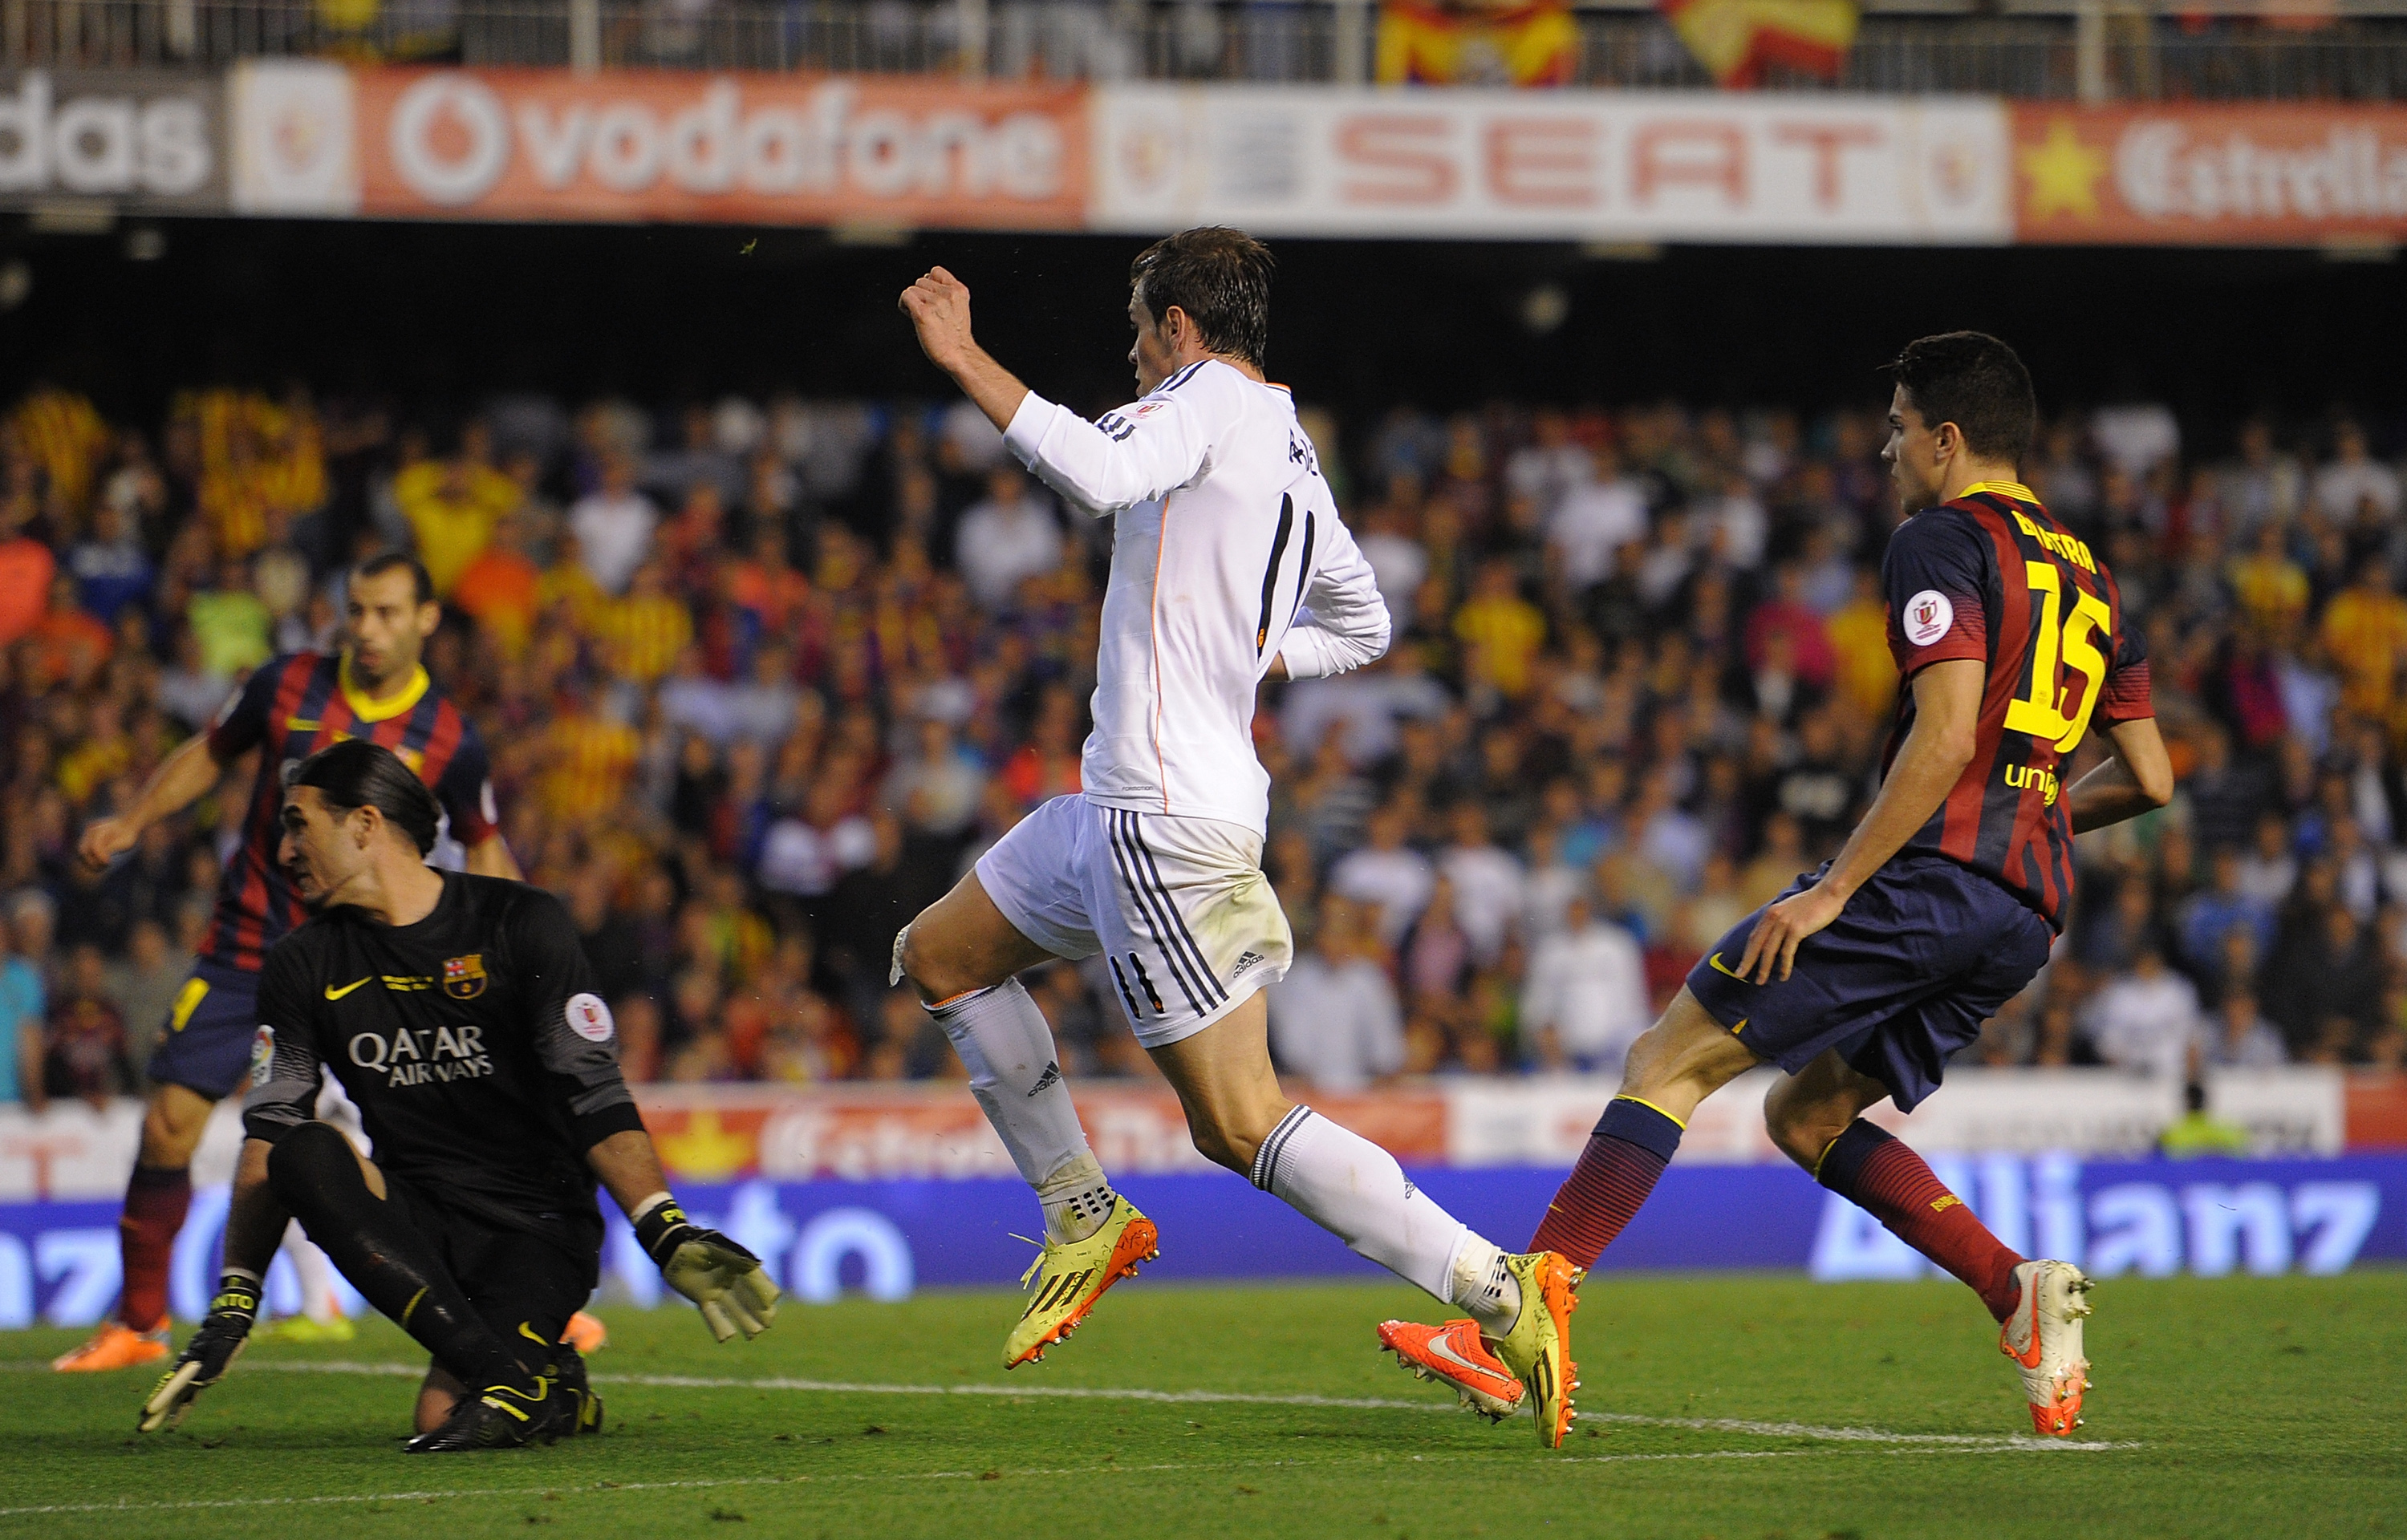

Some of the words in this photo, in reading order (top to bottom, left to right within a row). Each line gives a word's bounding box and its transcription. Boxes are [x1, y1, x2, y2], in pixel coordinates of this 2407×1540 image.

[513, 79, 1064, 202] vodafone
[1333, 114, 1885, 212] SEAT
[2003, 560, 2112, 753] 15
[2004, 763, 2054, 793] uni
[1110, 952, 1166, 1019] 11
[1232, 954, 1265, 979] adidas
[348, 1026, 487, 1073] QATAR
[388, 1053, 495, 1088] AIRWAYS
